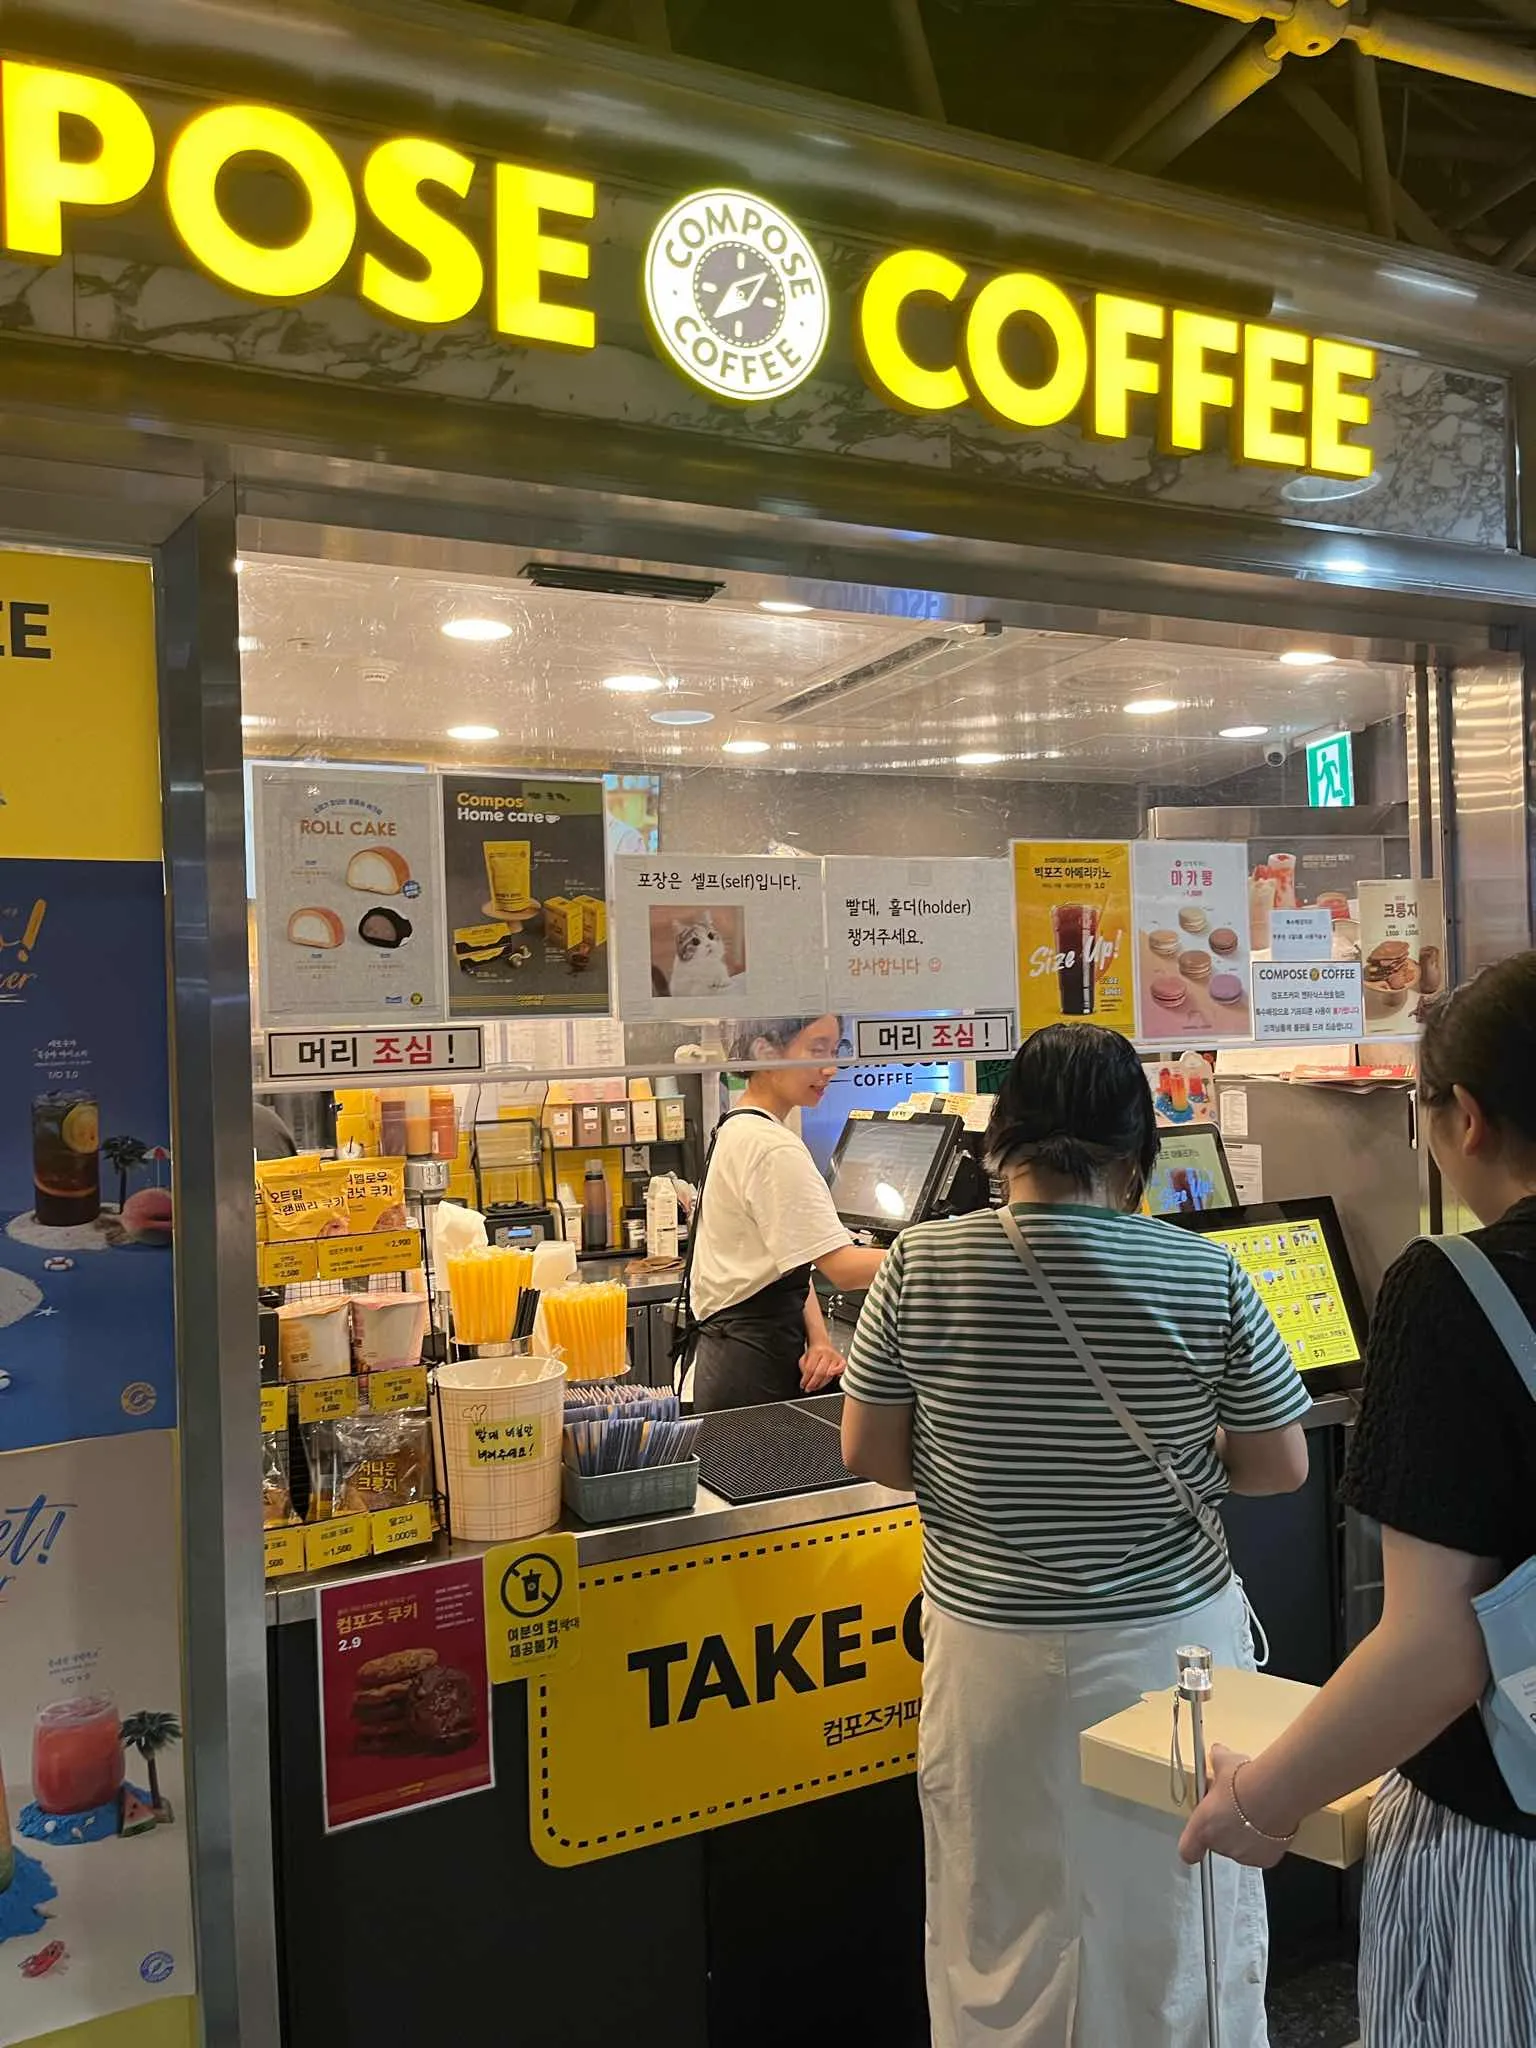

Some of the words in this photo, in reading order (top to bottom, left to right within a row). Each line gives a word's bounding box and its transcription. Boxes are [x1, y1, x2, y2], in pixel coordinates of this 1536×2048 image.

[665, 203, 816, 298] COMPOSE
[0, 58, 597, 349] POSE
[861, 249, 1375, 478] COFFEE
[674, 315, 802, 384] COFFEE
[457, 792, 526, 809] Compos
[457, 808, 504, 821] Home
[300, 820, 344, 834] ROLL
[350, 821, 397, 836] CAKE
[638, 872, 683, 890] 포장은
[691, 872, 801, 891] 셀프(self)입니다.
[1034, 866, 1063, 879] 빅포즈
[1065, 866, 1112, 879] 아메리카노
[846, 898, 879, 917] 빨대,
[889, 898, 971, 917] 홀더(holder)
[1384, 902, 1417, 918] 크룽지
[848, 928, 923, 946] 챙겨주세요.
[1029, 945, 1075, 977] Size
[1082, 929, 1122, 970] Up!
[848, 958, 919, 976] 감사합니다
[1260, 969, 1308, 980] COMPOSE
[1321, 969, 1355, 979] COFFEE
[879, 1024, 920, 1050] 머리
[932, 1023, 974, 1047] 조심
[984, 1022, 990, 1047] !
[299, 1038, 357, 1068] 머리
[373, 1035, 432, 1064] 조심
[448, 1034, 454, 1063] !
[270, 1188, 302, 1203] 오트밀
[371, 1184, 393, 1197] 쿠키
[358, 1476, 398, 1493] 크룽지
[337, 1611, 384, 1635] 컴포즈
[388, 1602, 418, 1624] 쿠키
[508, 1622, 544, 1642] 여분의
[338, 1636, 362, 1652] 2.9
[510, 1636, 559, 1658] 제공불가
